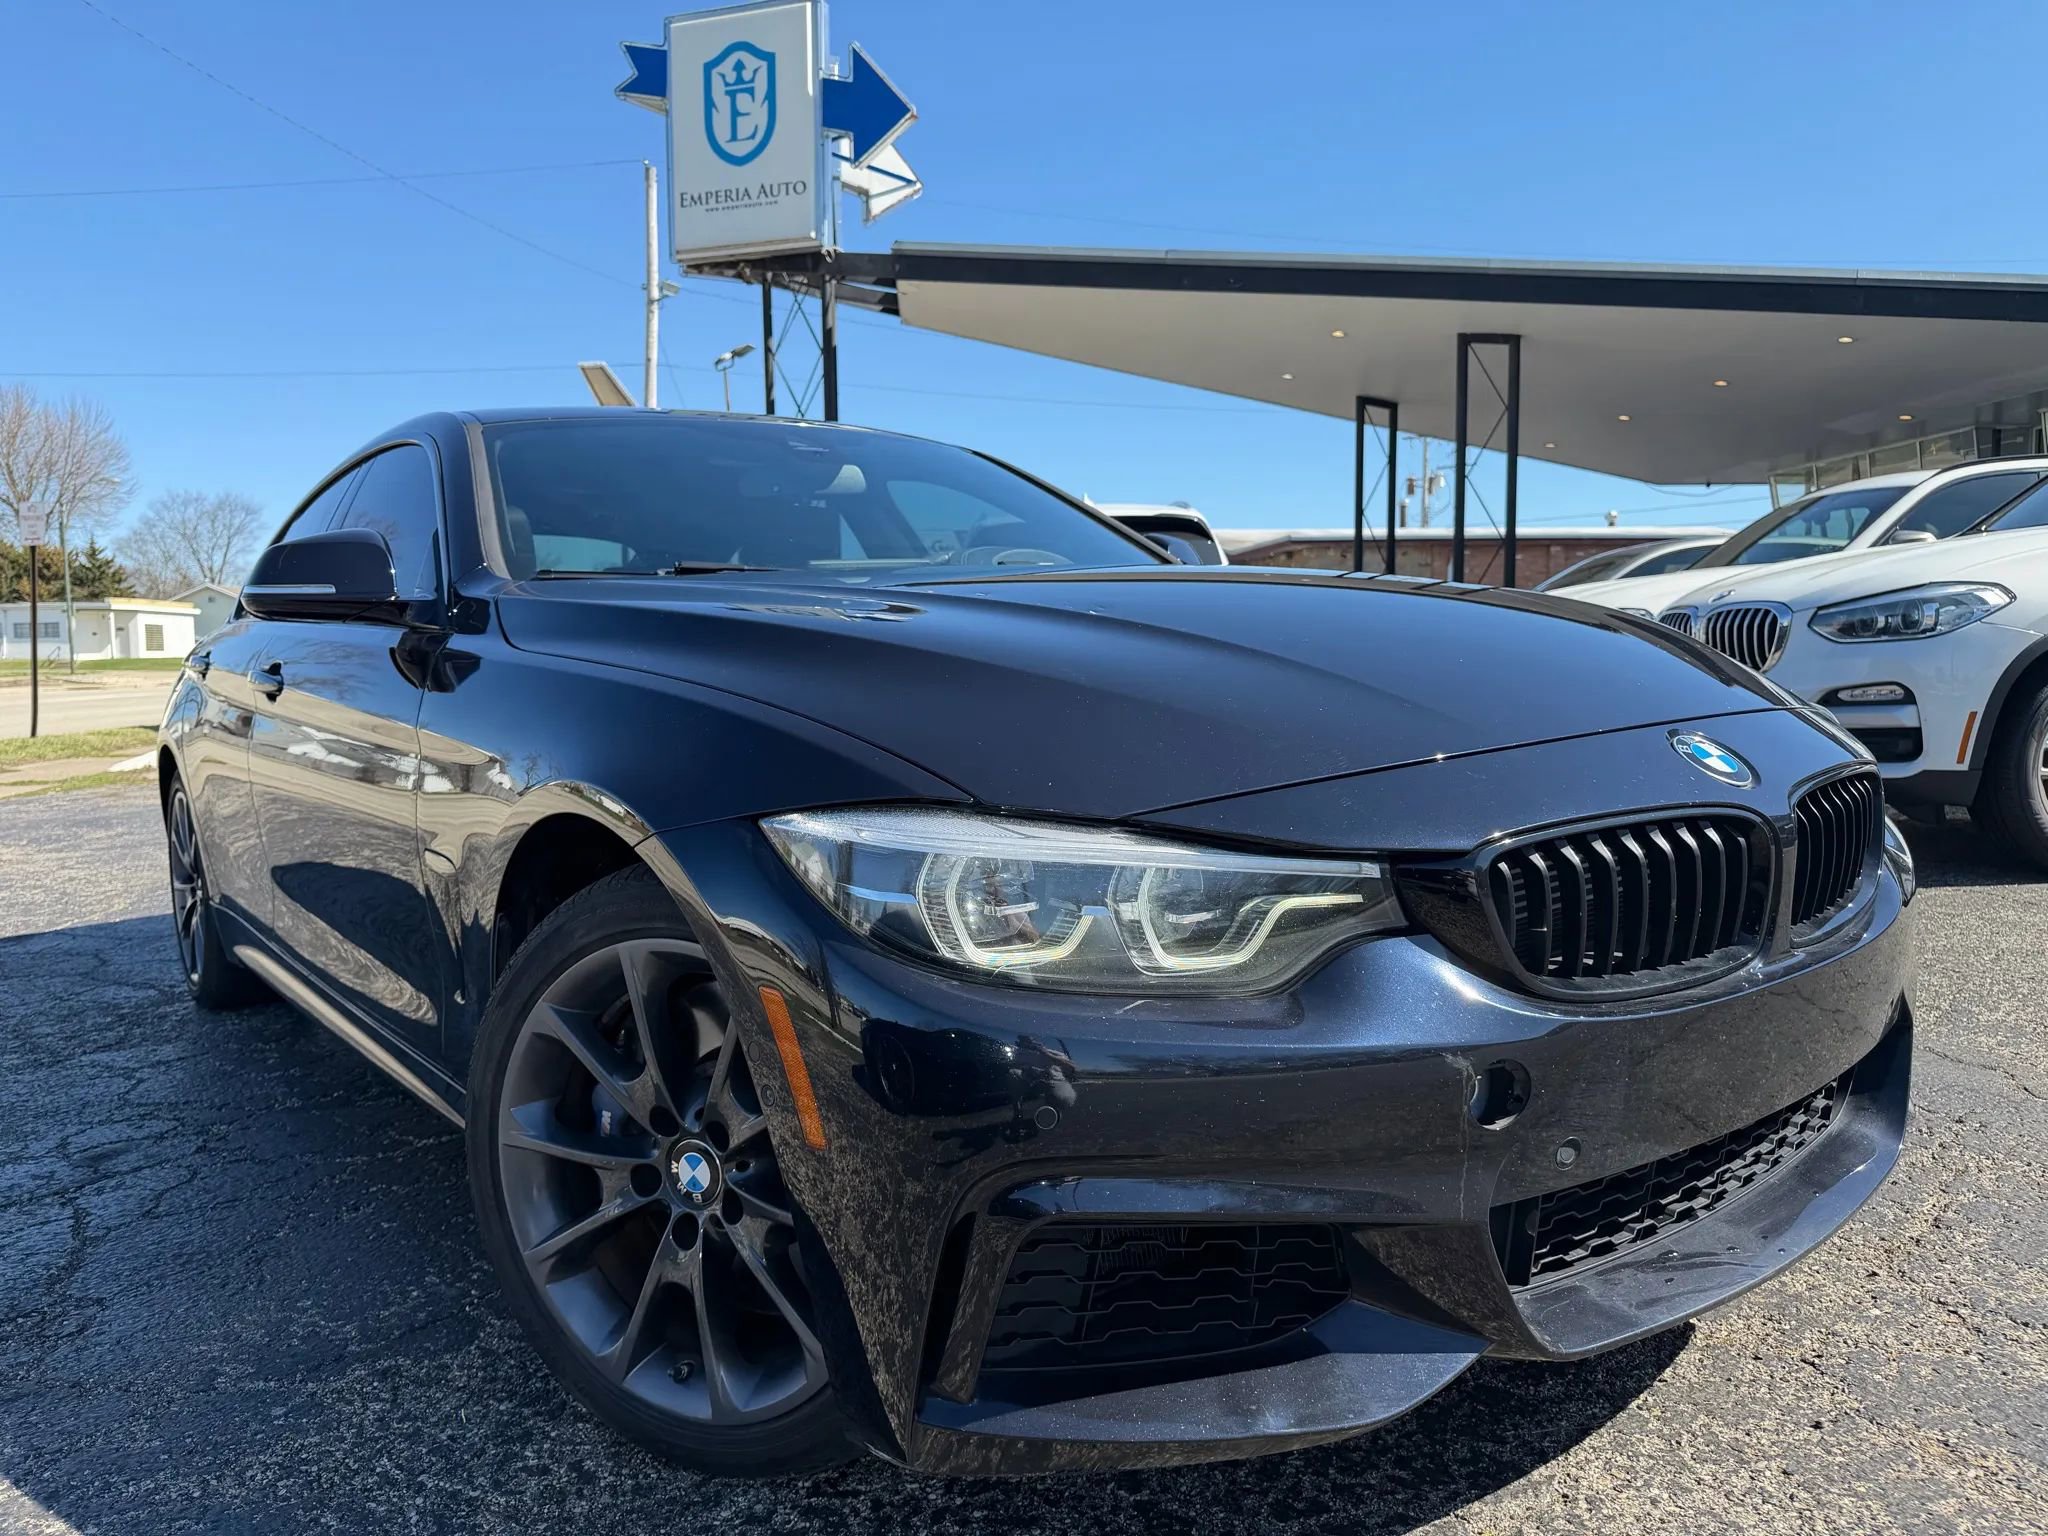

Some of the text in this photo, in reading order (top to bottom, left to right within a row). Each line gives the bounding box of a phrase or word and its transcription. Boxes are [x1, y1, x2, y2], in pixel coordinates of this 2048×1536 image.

[725, 86, 758, 143] E
[680, 180, 807, 208] EMPERIA AUTO
[670, 1160, 702, 1203] BMW
